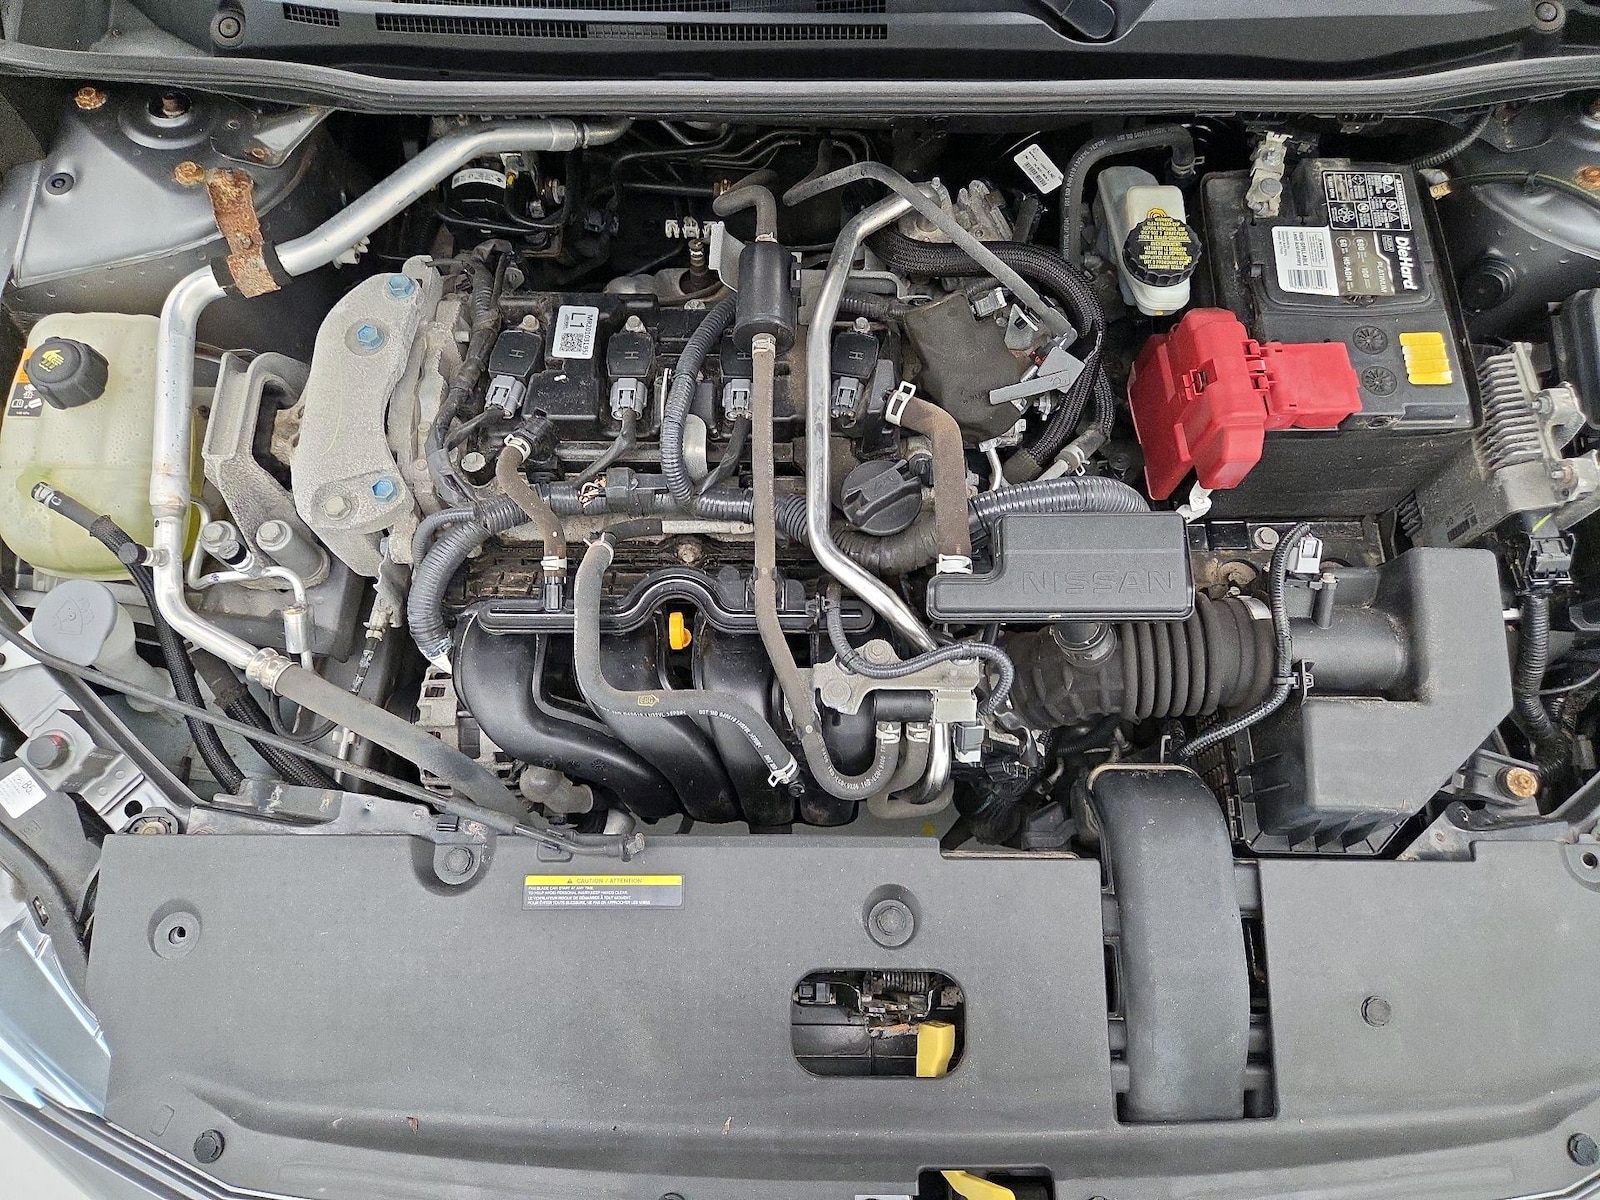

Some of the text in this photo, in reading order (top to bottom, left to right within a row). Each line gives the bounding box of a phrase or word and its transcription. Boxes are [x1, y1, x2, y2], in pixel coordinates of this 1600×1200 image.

[1395, 235, 1418, 290] DieHard
[1376, 261, 1387, 293] PLATINUM
[569, 312, 586, 328] L1
[1022, 570, 1173, 595] NISSAN
